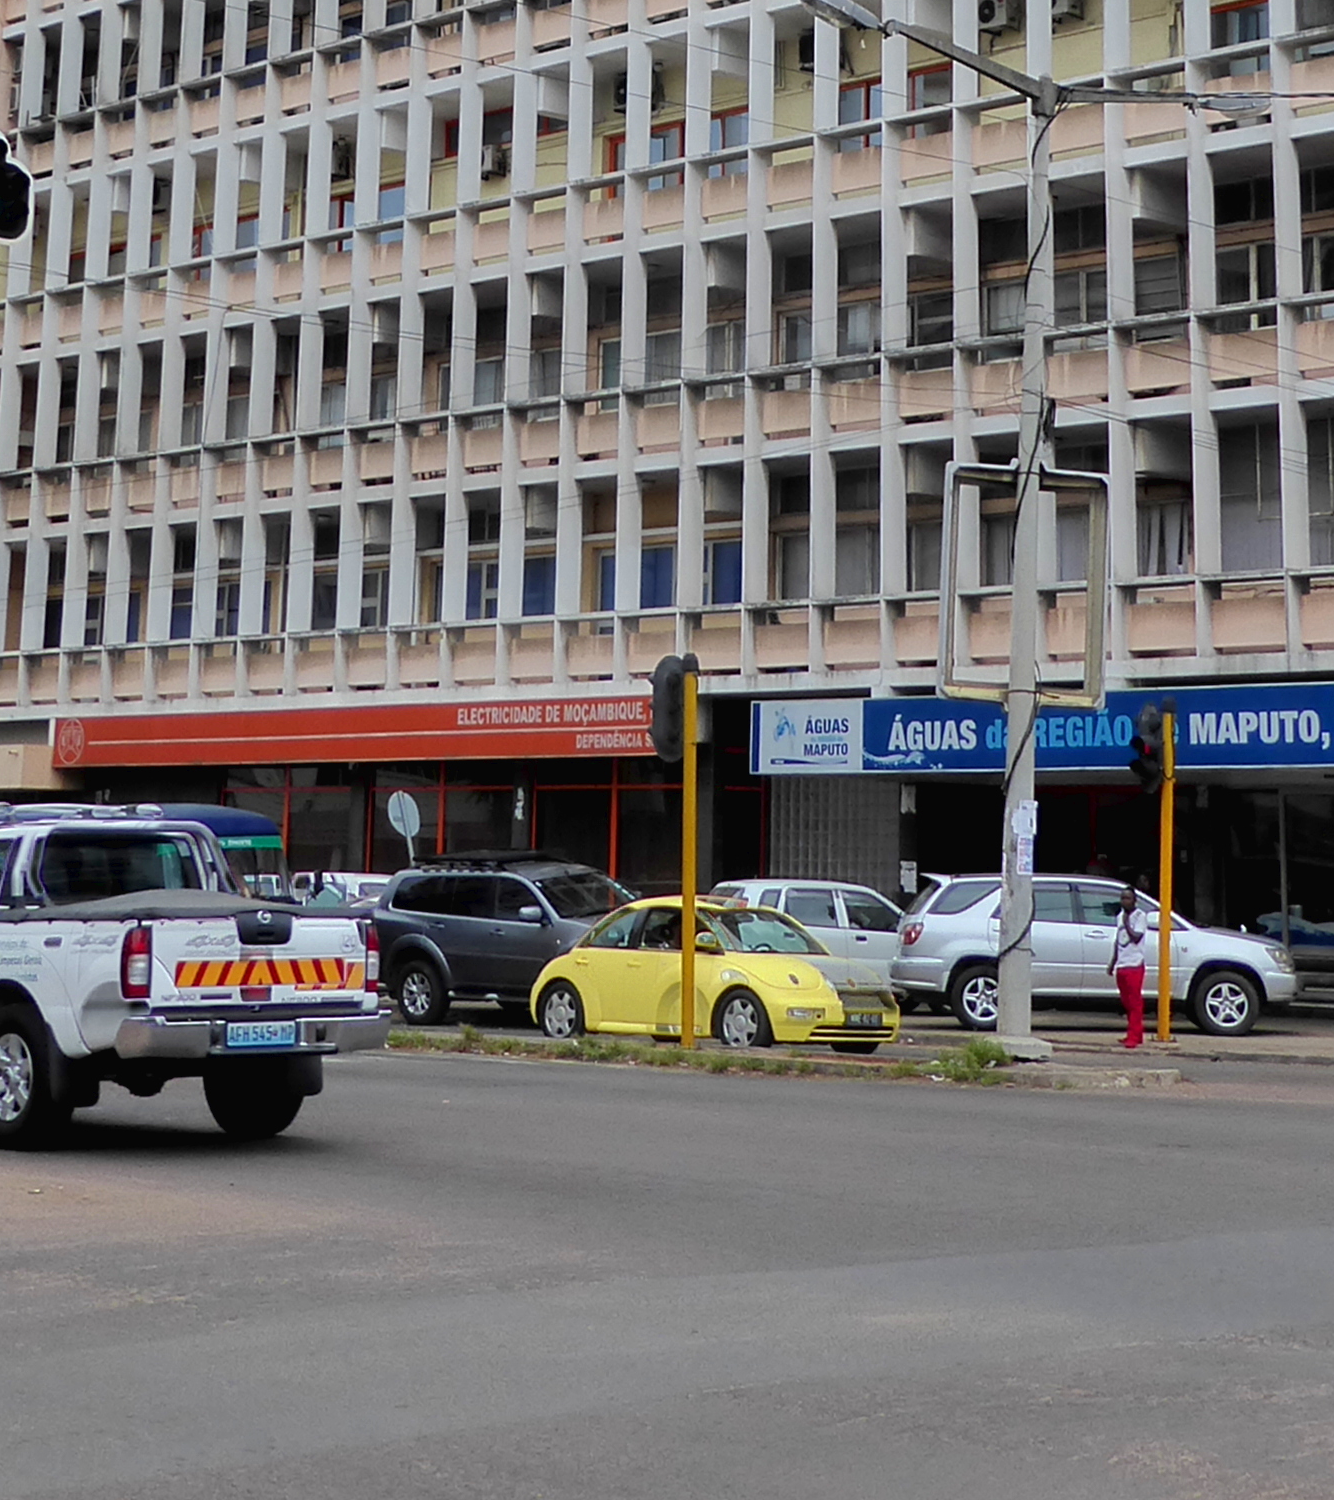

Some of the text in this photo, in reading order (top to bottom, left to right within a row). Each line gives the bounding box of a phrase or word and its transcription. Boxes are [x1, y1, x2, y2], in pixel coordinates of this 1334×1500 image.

[456, 705, 543, 726] ELECTRICIDADE
[545, 704, 560, 723] DE
[563, 700, 647, 726] MOÇAMBIQUE,
[804, 714, 850, 735] ÁGUAS
[887, 713, 978, 751] ÁGUAS
[1033, 707, 1133, 749] REGIÃO
[1188, 709, 1331, 750] MAPUTO,
[575, 729, 643, 749] DEPENDÊNCIA
[803, 742, 849, 757] MAPUTO
